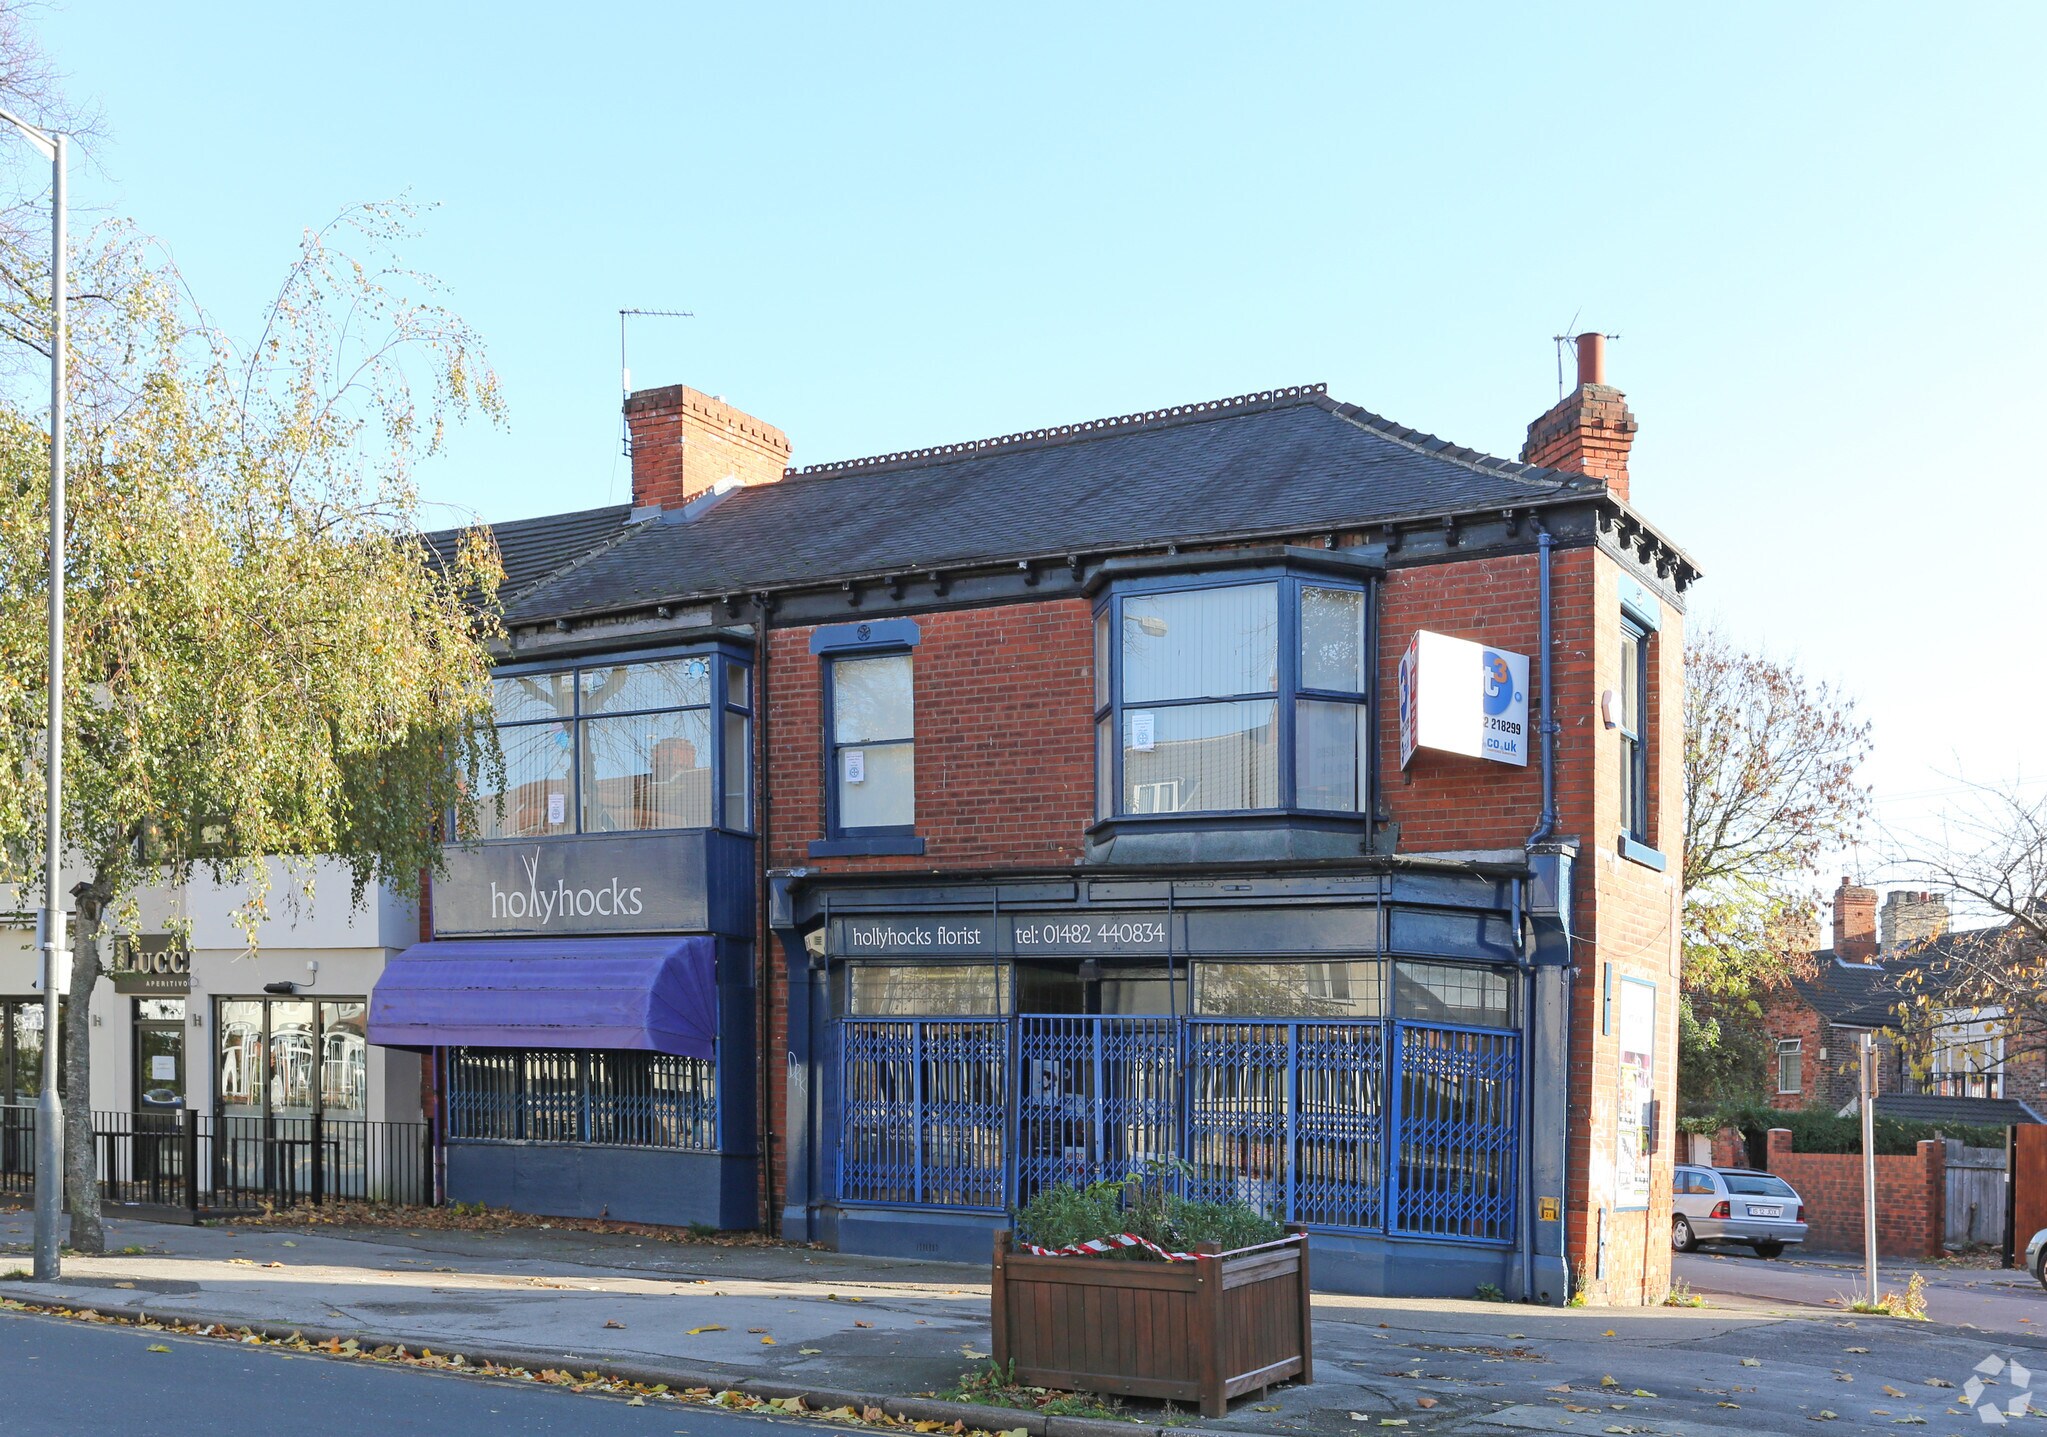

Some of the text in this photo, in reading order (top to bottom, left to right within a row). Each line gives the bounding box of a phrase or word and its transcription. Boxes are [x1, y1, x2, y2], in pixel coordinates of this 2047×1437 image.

[1491, 717, 1521, 736] 218299
[490, 846, 643, 925] hollyhocks
[852, 923, 1166, 949] hollyhocks florist tel: 01482 440834
[116, 940, 191, 974] LUCC
